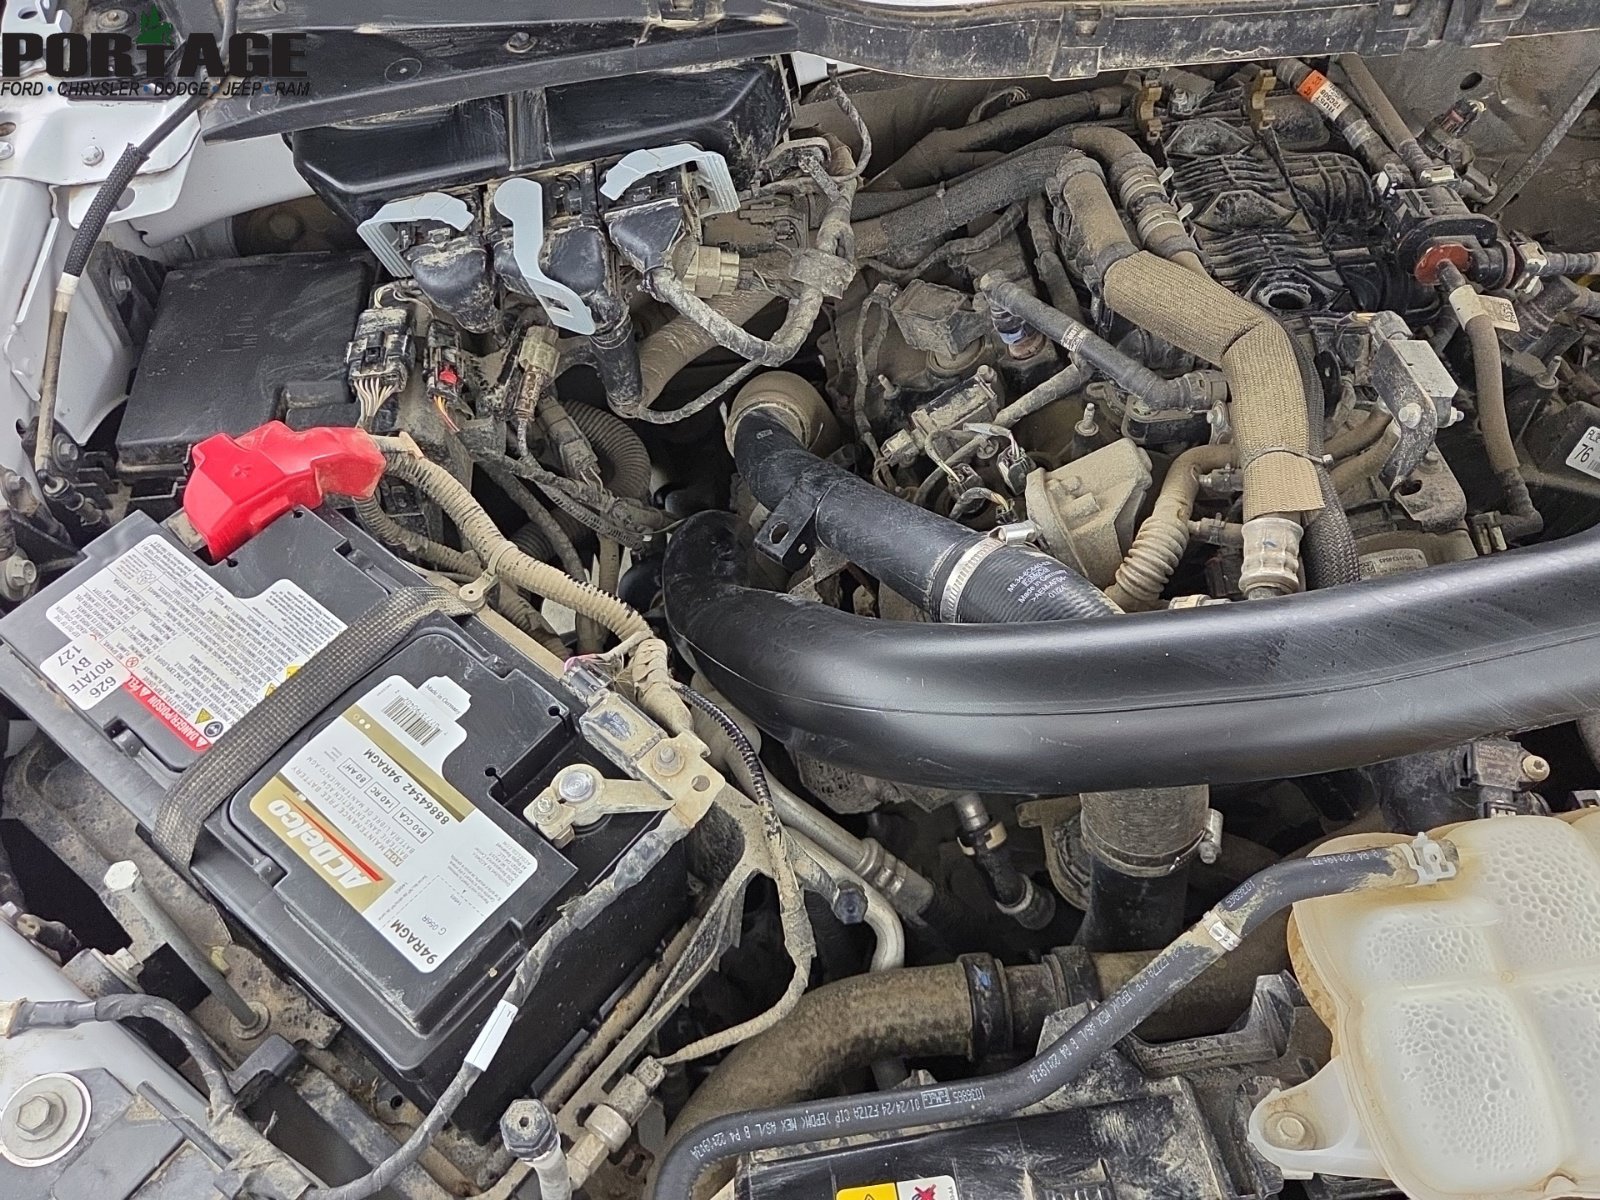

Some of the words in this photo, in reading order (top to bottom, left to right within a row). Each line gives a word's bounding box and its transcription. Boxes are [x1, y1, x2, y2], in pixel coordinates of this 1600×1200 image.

[1574, 443, 1594, 463] 76
[53, 643, 83, 667] 127
[68, 655, 92, 675] BY
[67, 656, 115, 695] ROTATE
[87, 673, 118, 700] 626
[145, 693, 200, 742] DANGER/POISON
[362, 747, 404, 784] 94RAGM
[289, 763, 322, 793] BATTERY
[320, 779, 335, 792] AGM
[354, 772, 367, 784] 80
[319, 790, 339, 809] FREE
[369, 785, 382, 797] RC
[378, 794, 395, 808] 140
[333, 790, 365, 820] ENTRETIEN
[401, 781, 451, 825] 88864542
[363, 818, 382, 834] SANS
[397, 810, 414, 826] CCA
[337, 807, 387, 851] MAINTENANCE
[411, 822, 428, 838] 850
[267, 799, 372, 889] ACDelco
[379, 832, 409, 859] BATTERIE
[383, 848, 403, 866] AGM
[1224, 878, 1255, 908] 1036865
[420, 913, 440, 931] 056R
[388, 918, 439, 965] 94RAGM
[880, 1097, 919, 1116] 01/24/24
[779, 1116, 797, 1131] MEX
